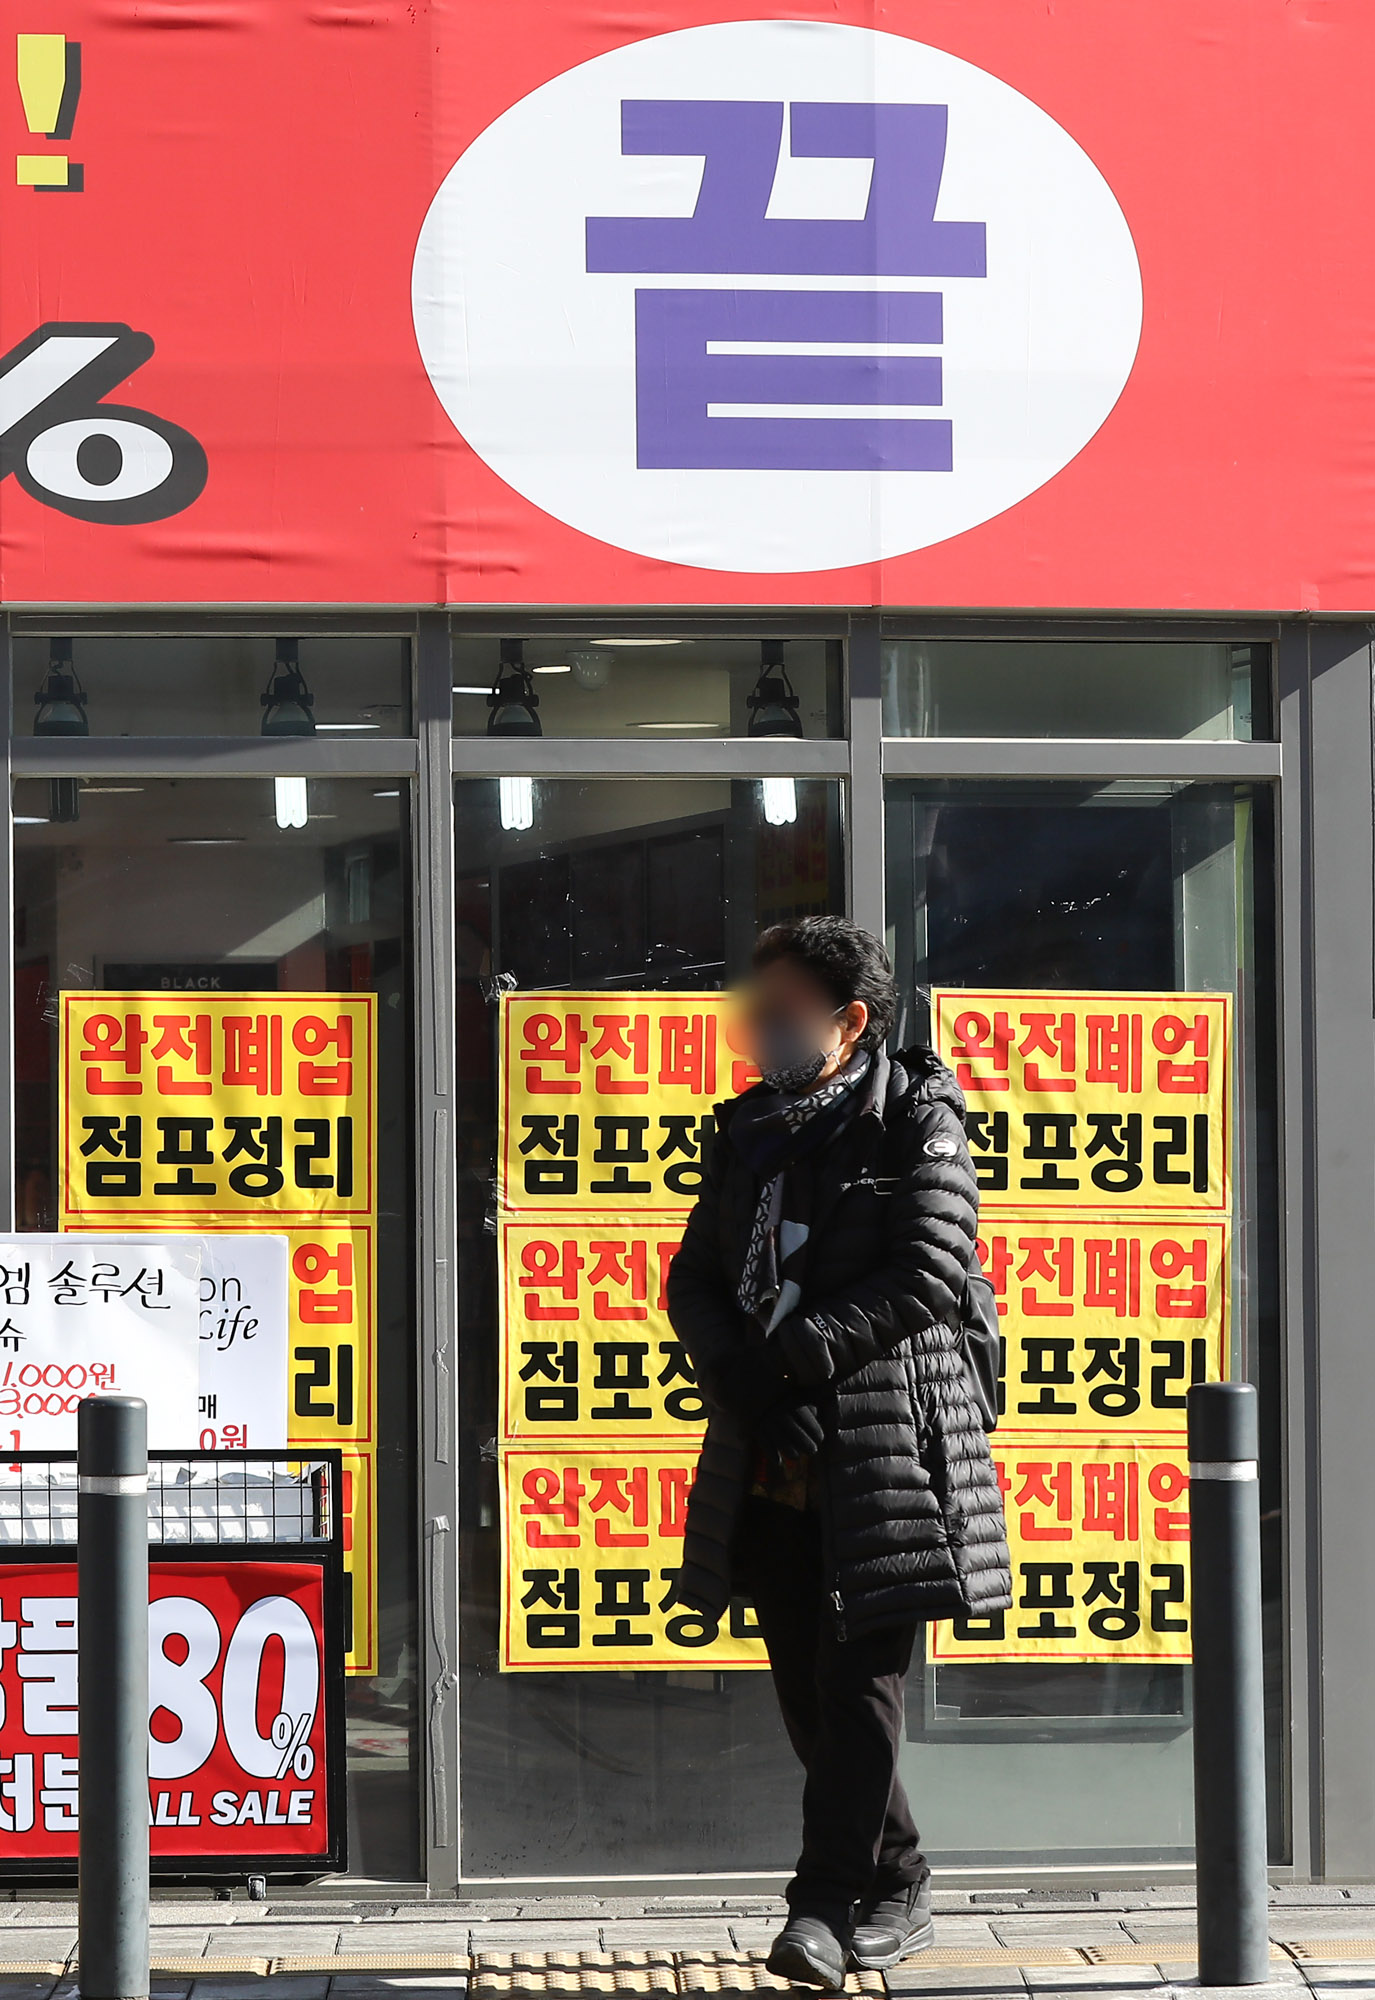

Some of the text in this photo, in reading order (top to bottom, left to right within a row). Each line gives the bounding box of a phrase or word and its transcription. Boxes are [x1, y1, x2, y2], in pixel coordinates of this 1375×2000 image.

[585, 99, 987, 472] 끝
[161, 976, 222, 990] BLACK
[80, 1013, 353, 1096] 완전폐업
[951, 1011, 1209, 1094] 완전폐업
[79, 1115, 353, 1197] 점포정리
[518, 1115, 717, 1195] 점포정
[47, 1260, 171, 1309] 솔루션
[292, 1241, 353, 1325] 업
[519, 1239, 680, 1322] 완전
[294, 1343, 353, 1426] 리
[998, 1337, 1207, 1417] 포정리
[199, 1424, 248, 1450] 0원
[997, 1461, 1191, 1542] 전폐업
[149, 1790, 315, 1826] LL SALE
